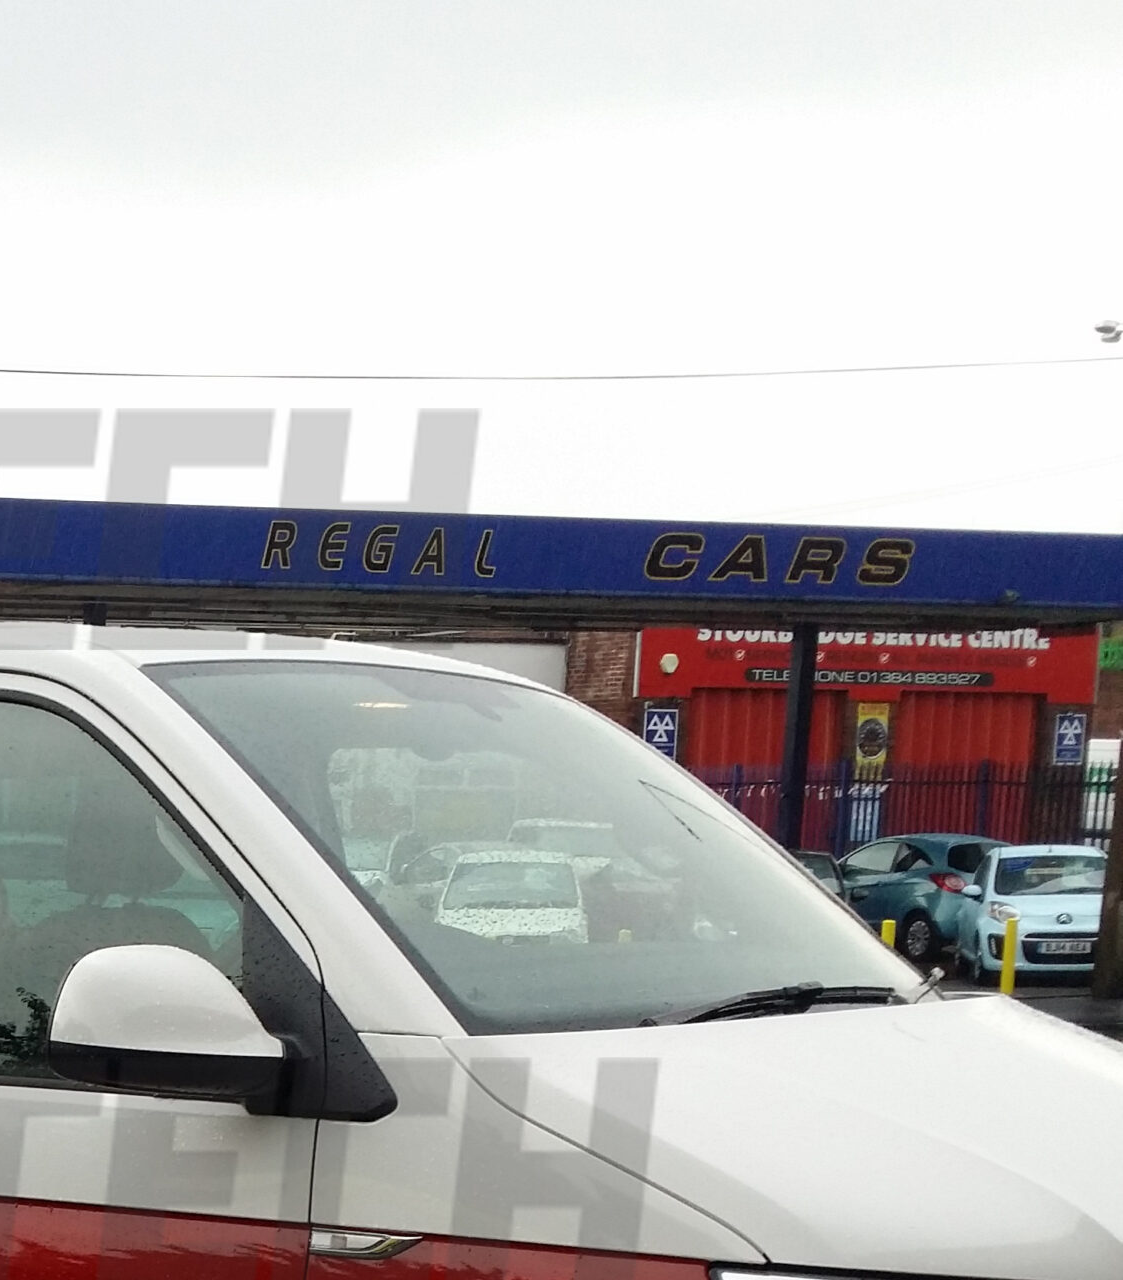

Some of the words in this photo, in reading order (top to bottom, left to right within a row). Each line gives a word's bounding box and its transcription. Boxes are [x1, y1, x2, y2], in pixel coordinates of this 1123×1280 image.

[261, 520, 497, 578] REGAL
[644, 532, 916, 586] CARS
[697, 628, 867, 645] STOURBDGE
[968, 627, 1051, 650] CENTRE
[752, 669, 855, 683] TELEONE
[857, 671, 912, 684] 01384
